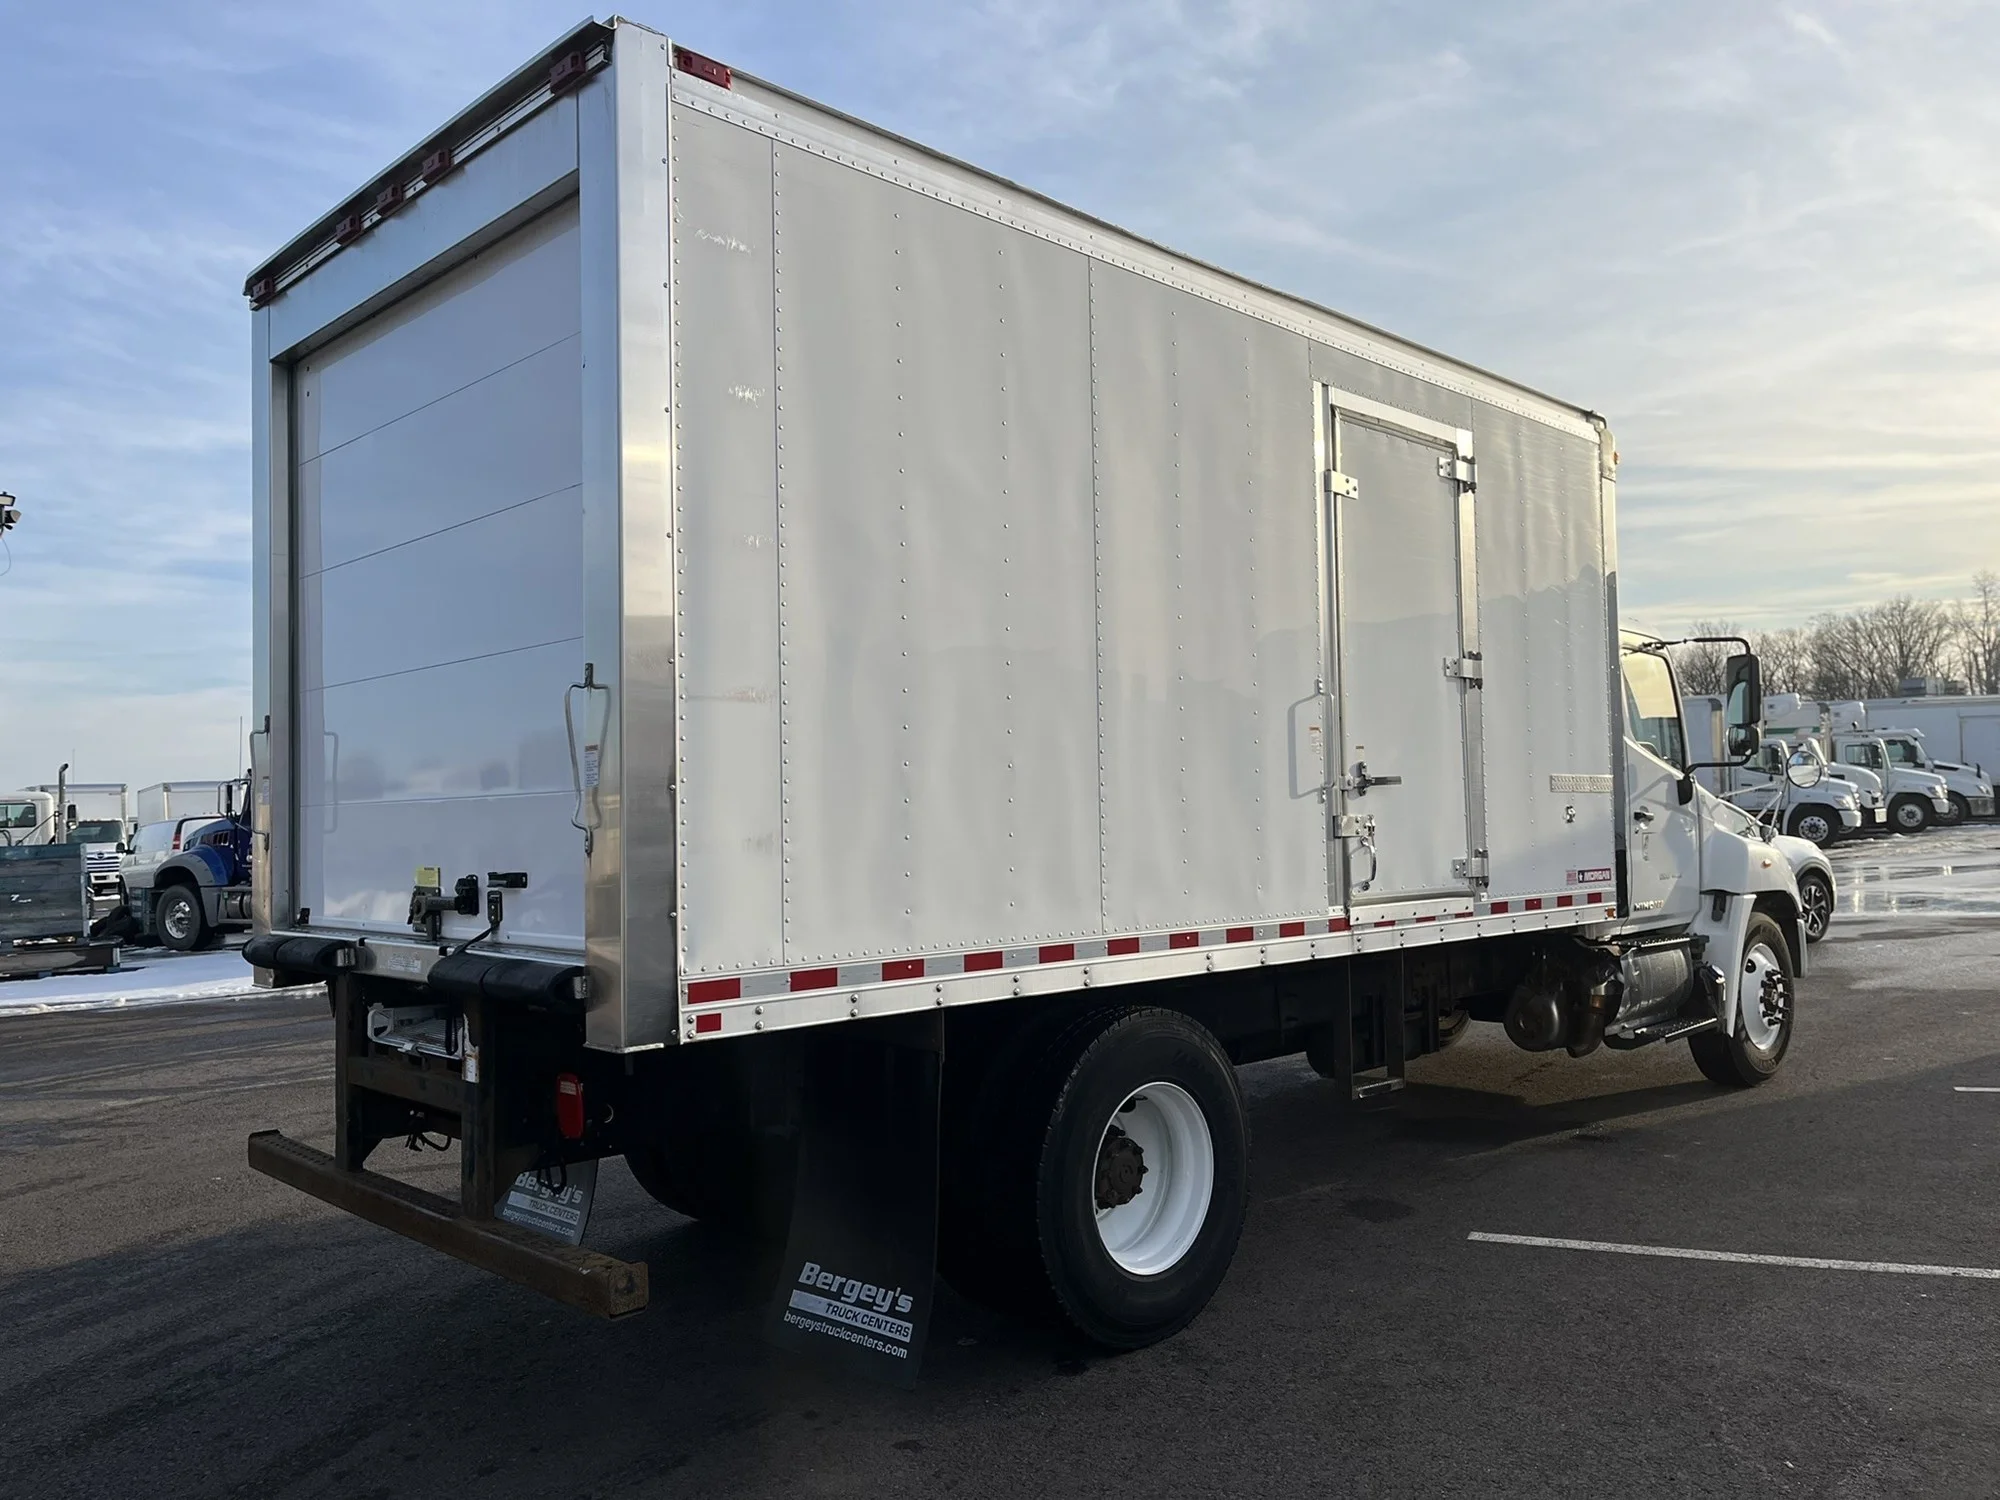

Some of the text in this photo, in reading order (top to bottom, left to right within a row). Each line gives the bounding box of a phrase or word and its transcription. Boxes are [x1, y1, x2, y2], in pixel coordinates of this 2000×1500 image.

[1584, 870, 1610, 881] MORGAN
[515, 1171, 583, 1204] Bergy's
[798, 1261, 914, 1313] Bergey's
[783, 1310, 908, 1359] bergeystruckcenters.com
[825, 1303, 911, 1338] TRUCK CENTERS
